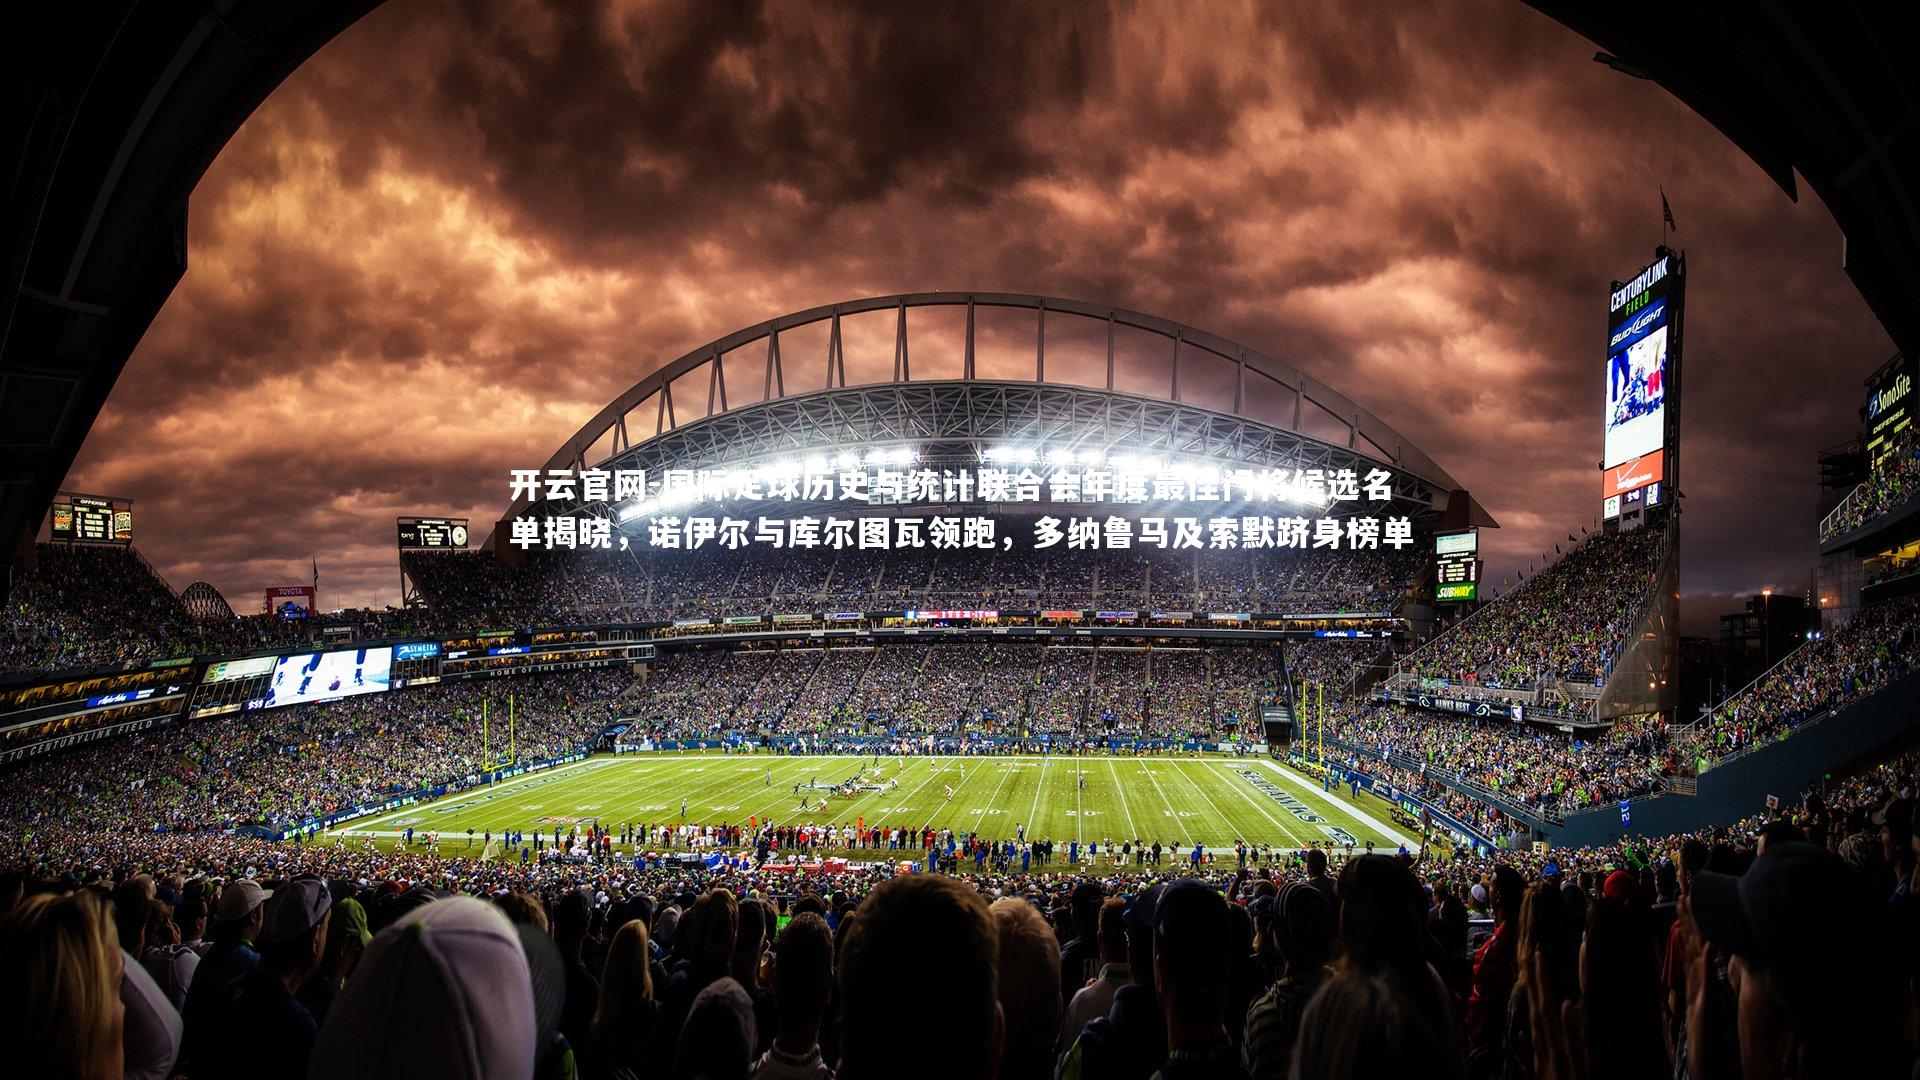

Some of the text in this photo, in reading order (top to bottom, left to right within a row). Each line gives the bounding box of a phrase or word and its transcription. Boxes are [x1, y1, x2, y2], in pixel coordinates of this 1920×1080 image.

[1610, 256, 1668, 313] CENTURYLINK
[1625, 290, 1650, 316] FIELD
[1610, 306, 1665, 347] BUD LIGHT
[1877, 373, 1911, 414] SonoSite
[1872, 407, 1905, 434] DEFENSE
[1437, 585, 1474, 598] SUBWAY
[490, 669, 515, 677] HOME
[1455, 701, 1470, 712] NEST
[9, 750, 24, 762] TO
[30, 729, 111, 756] CENTURYLINK
[118, 720, 153, 734] FIELD
[1621, 806, 1630, 822] 12
